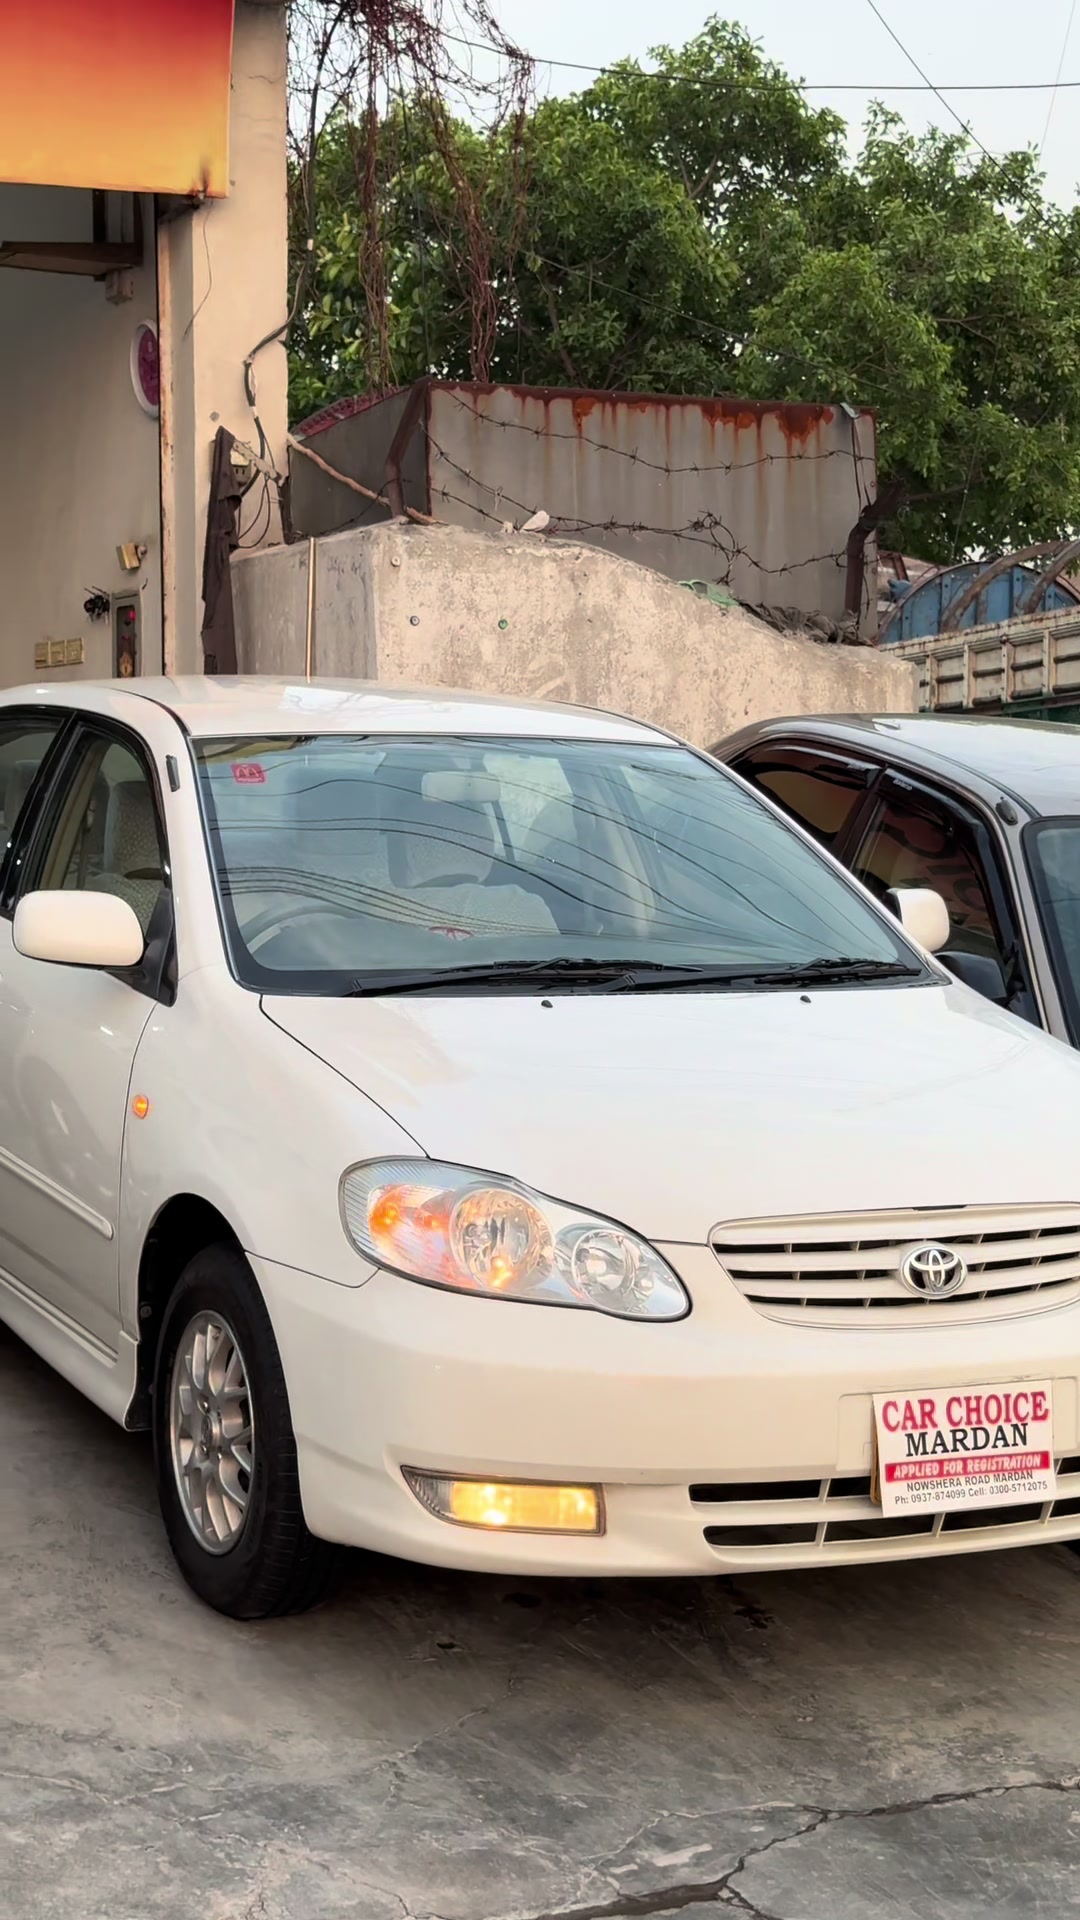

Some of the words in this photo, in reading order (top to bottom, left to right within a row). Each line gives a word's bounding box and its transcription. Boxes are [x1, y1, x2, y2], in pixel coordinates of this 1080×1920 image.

[882, 1398, 938, 1432] CAR
[946, 1391, 1050, 1427] CHOICE
[905, 1423, 1028, 1457] MARDAN
[894, 1462, 940, 1479] APPLIED
[943, 1460, 963, 1475] FOR
[967, 1454, 1041, 1473] REGISTRATION
[907, 1478, 962, 1492] NOWSHERA
[965, 1474, 990, 1486] ROAD
[993, 1470, 1033, 1483] MARDAN
[894, 1496, 909, 1505] Ph:
